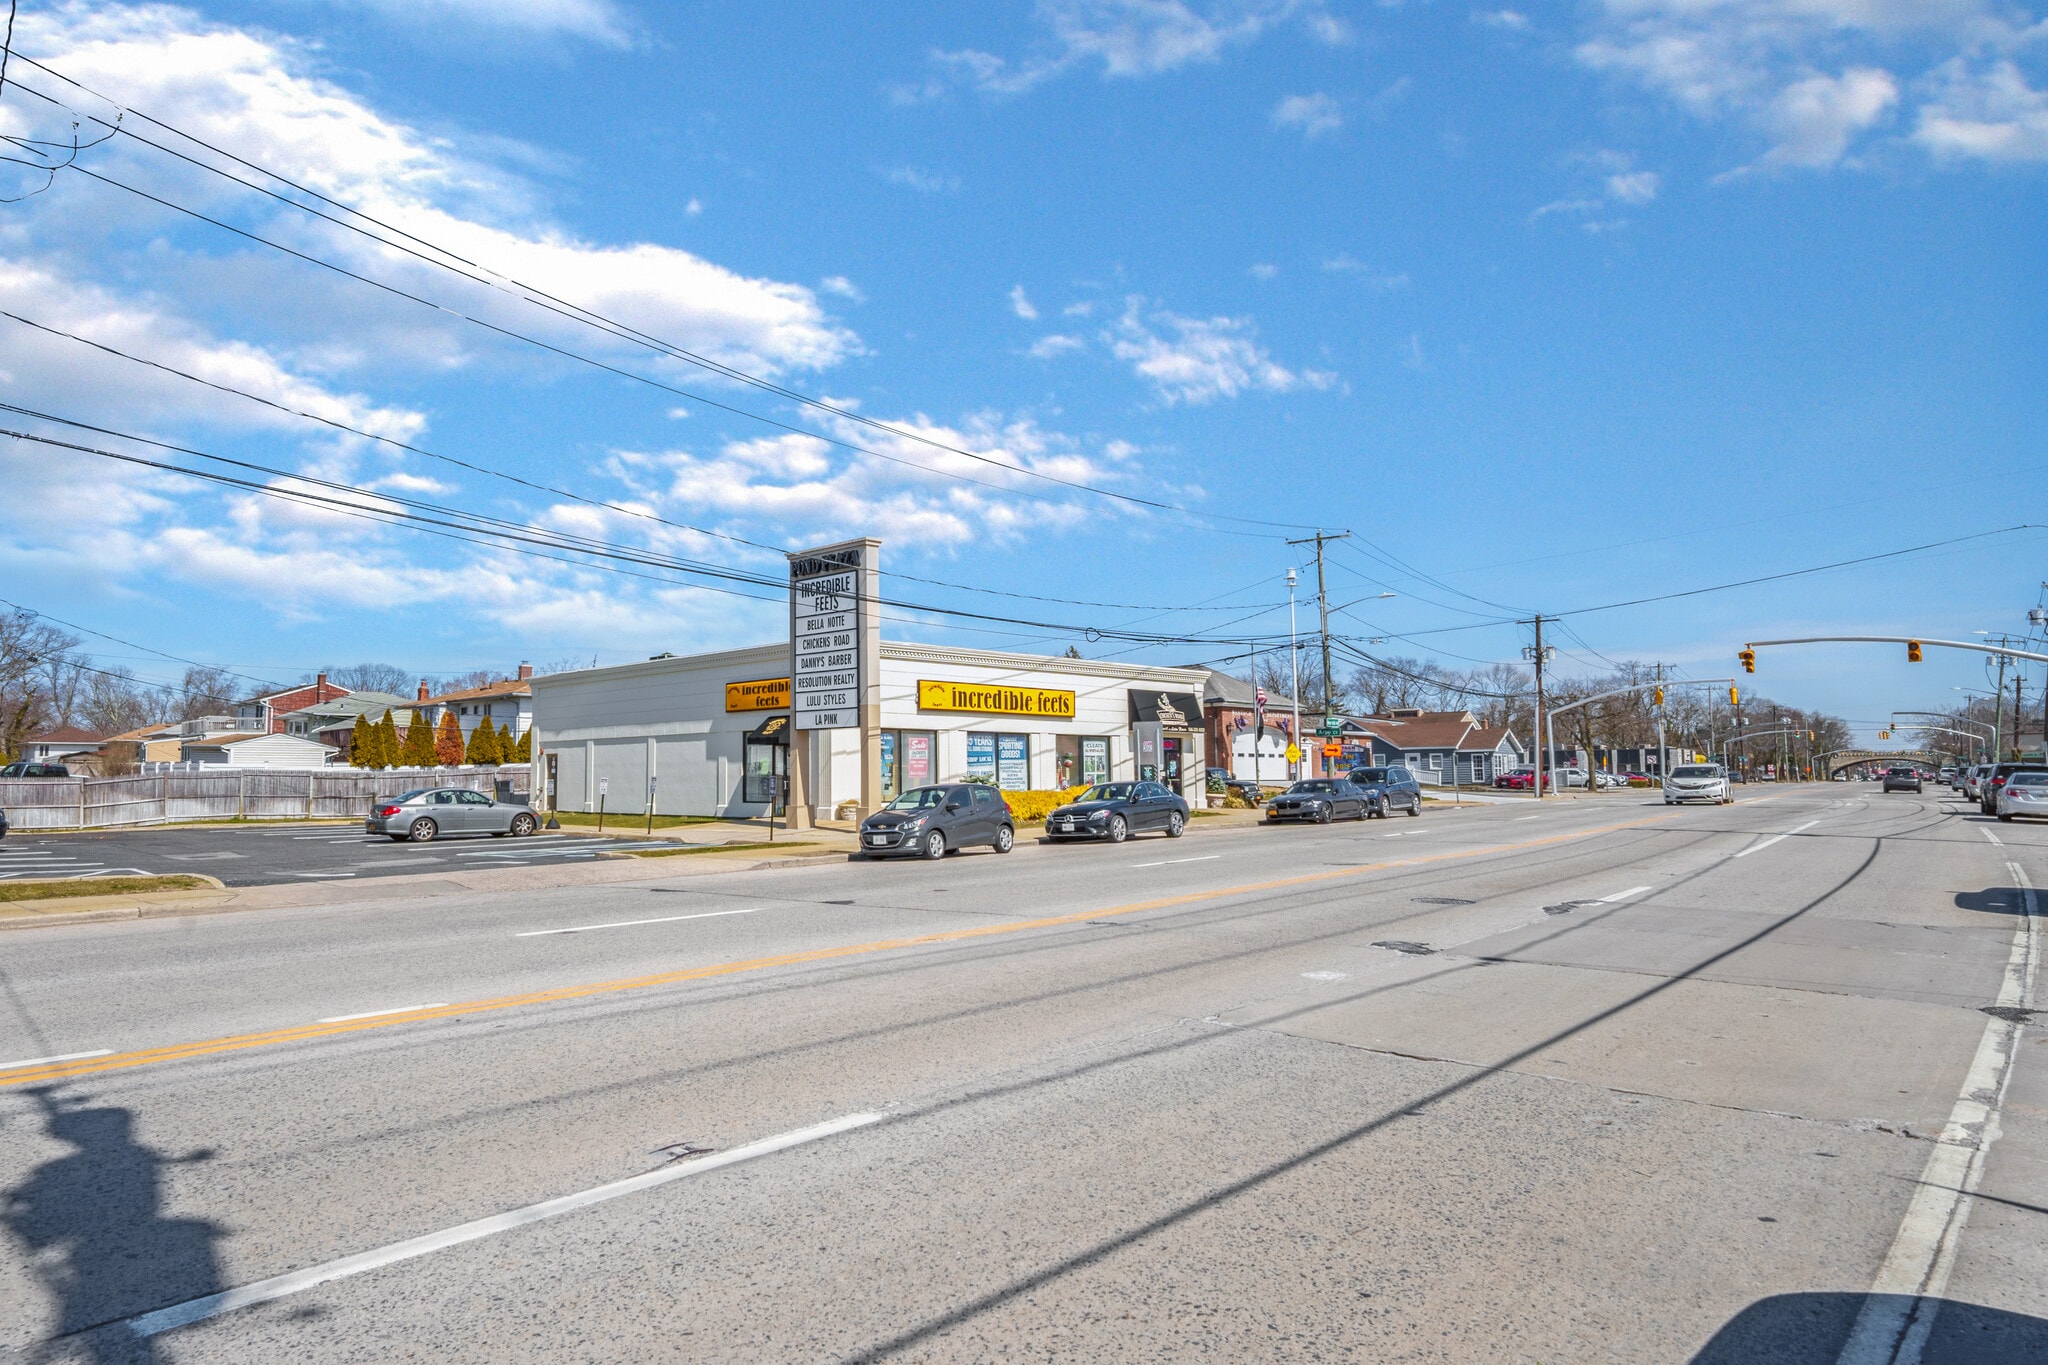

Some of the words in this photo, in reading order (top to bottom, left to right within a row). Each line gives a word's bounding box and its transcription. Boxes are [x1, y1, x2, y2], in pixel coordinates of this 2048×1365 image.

[801, 576, 850, 598] INCREDIBLE
[815, 595, 839, 612] FEETS
[807, 618, 824, 631] BELLA
[828, 615, 845, 628] NOTTE
[802, 636, 830, 650] CHICKENS
[834, 633, 850, 646] ROAD
[801, 656, 825, 669] DANNY'S
[828, 653, 852, 666] BARBER
[742, 681, 790, 695] incredibl
[798, 675, 832, 688] RESOLUTION
[834, 673, 855, 686] REALTY
[756, 695, 780, 707] feets
[806, 695, 821, 707] LULU
[824, 693, 846, 705] STYLES
[952, 687, 1032, 712] incredible
[1038, 692, 1069, 713] feets
[815, 714, 822, 725] LA
[824, 713, 838, 725] PINK
[911, 740, 926, 749] Sale
[998, 741, 1023, 750] SPORTING
